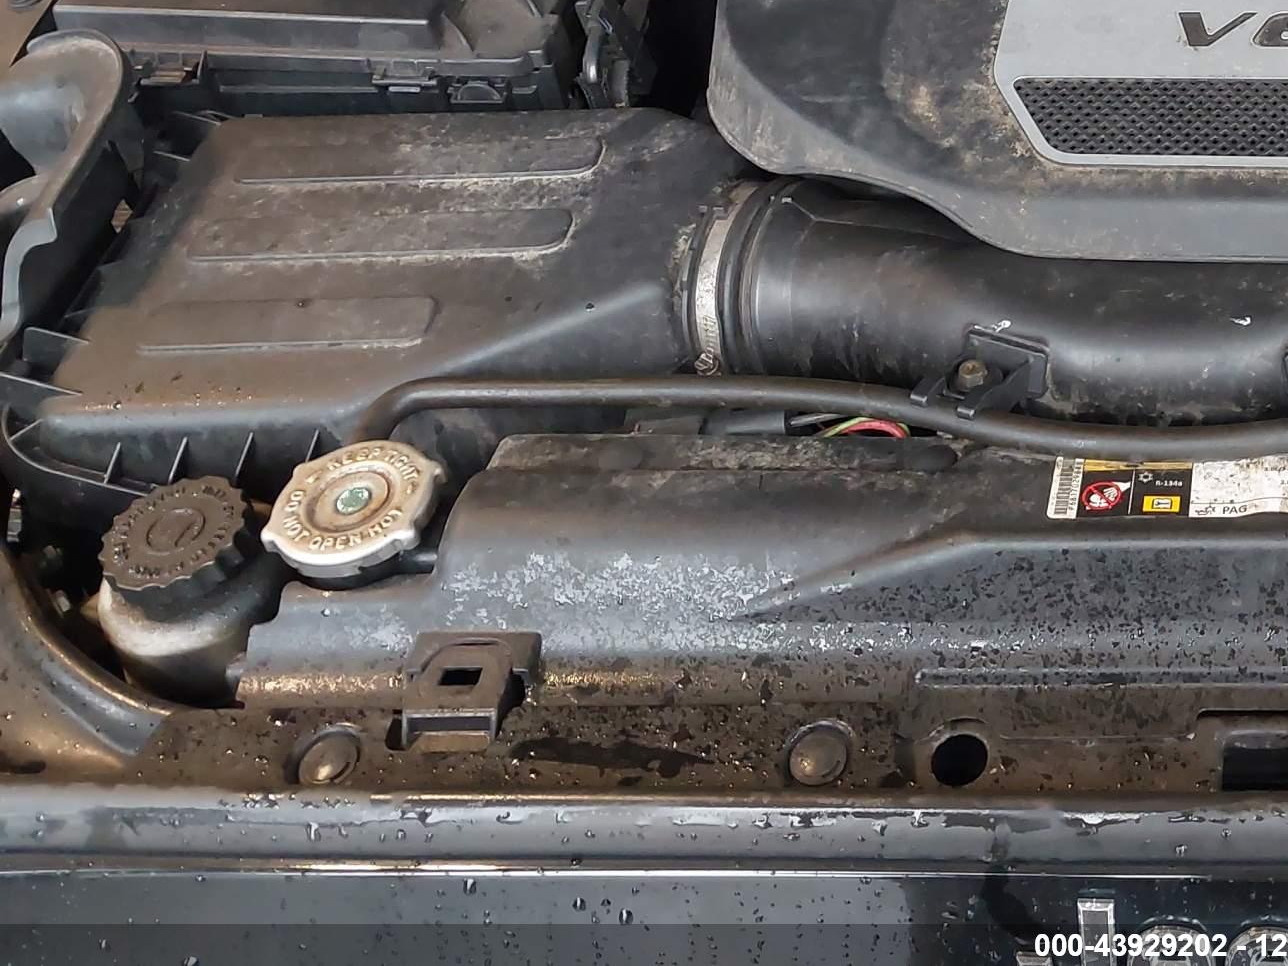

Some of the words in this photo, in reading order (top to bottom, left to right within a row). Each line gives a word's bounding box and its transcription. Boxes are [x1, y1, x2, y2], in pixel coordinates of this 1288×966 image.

[327, 447, 383, 472] KEEP
[384, 449, 421, 481] TIGHT
[284, 489, 306, 513] DO
[1222, 505, 1248, 515] PAG
[283, 516, 311, 543] NOT
[367, 507, 403, 538] HOT
[308, 530, 364, 551] OPEN
